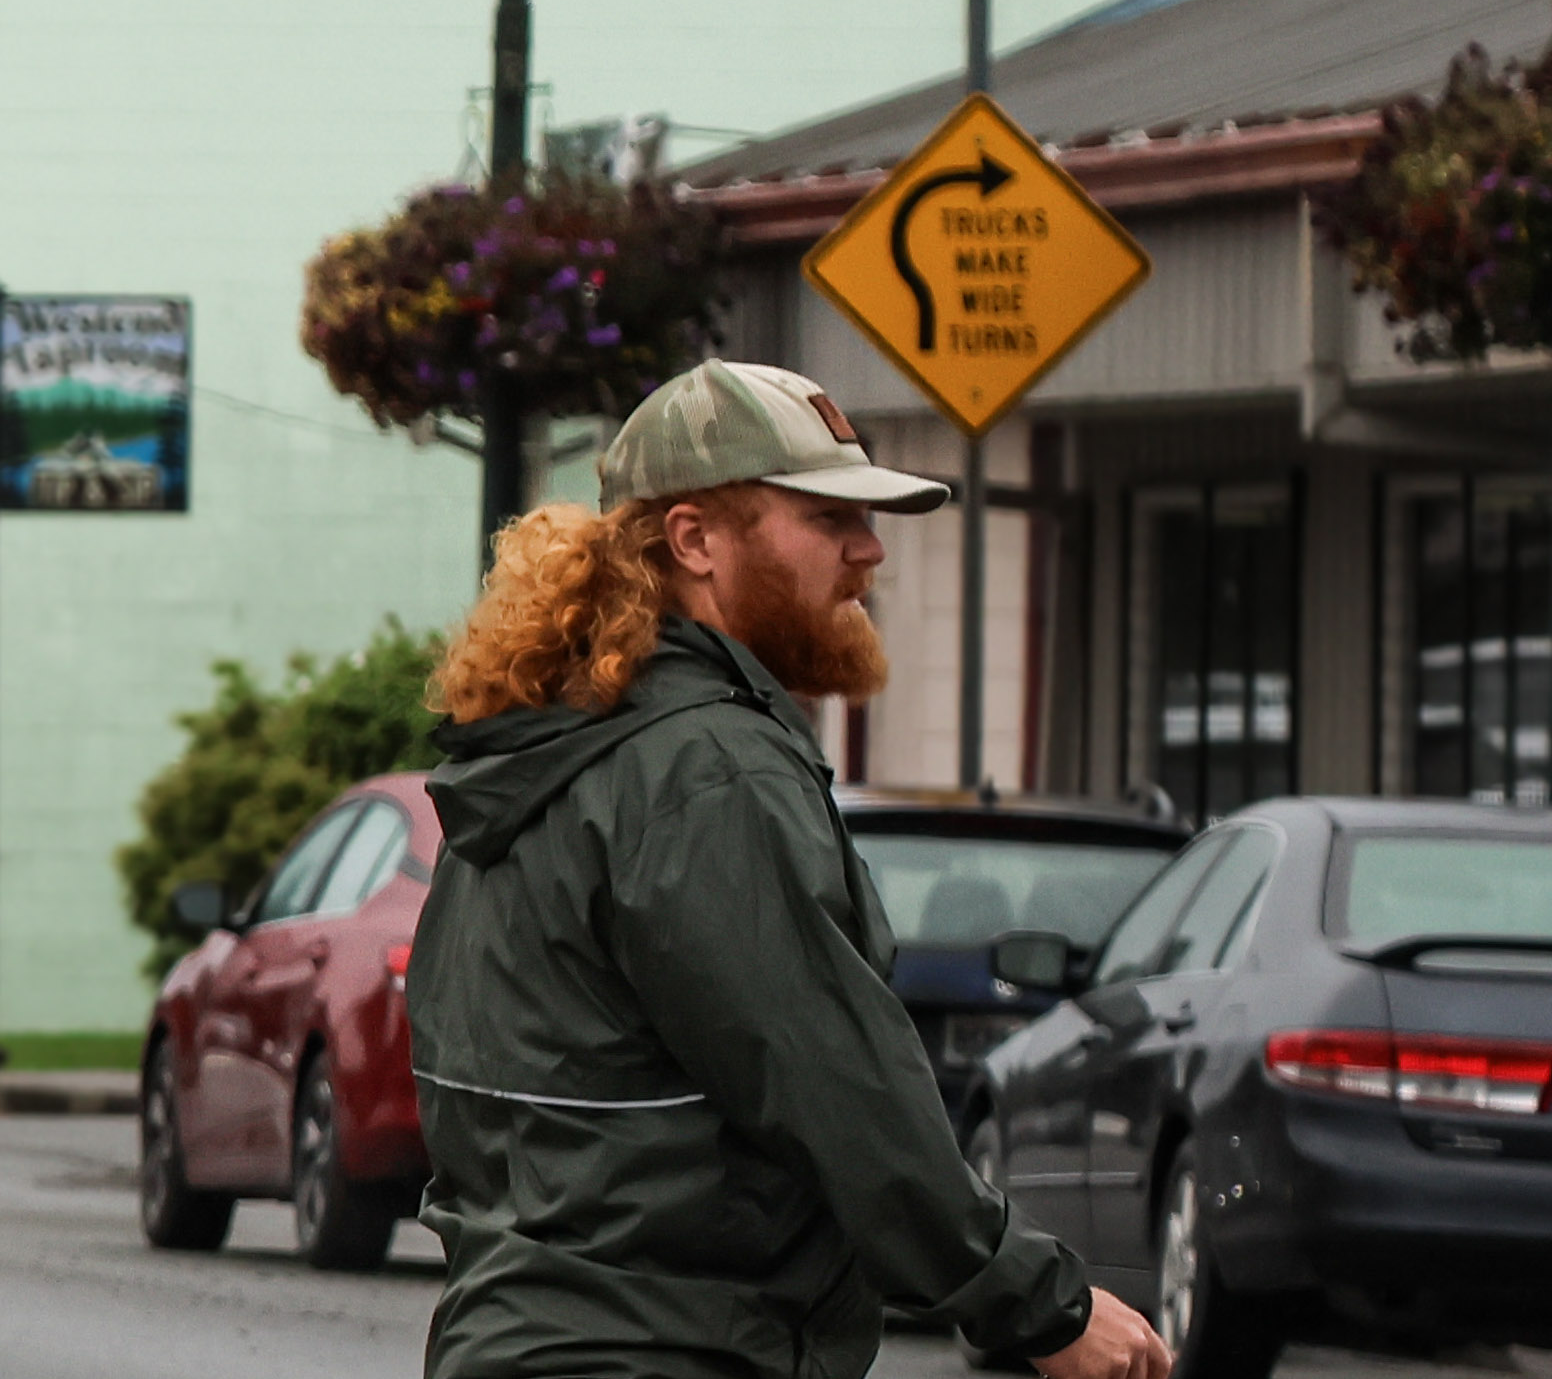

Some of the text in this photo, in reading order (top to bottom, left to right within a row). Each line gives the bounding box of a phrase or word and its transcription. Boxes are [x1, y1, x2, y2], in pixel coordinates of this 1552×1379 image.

[942, 207, 1049, 240] TRUCKS
[955, 247, 1031, 276] MAKE
[960, 284, 1027, 314] WIDE
[948, 324, 1039, 356] TURNS
